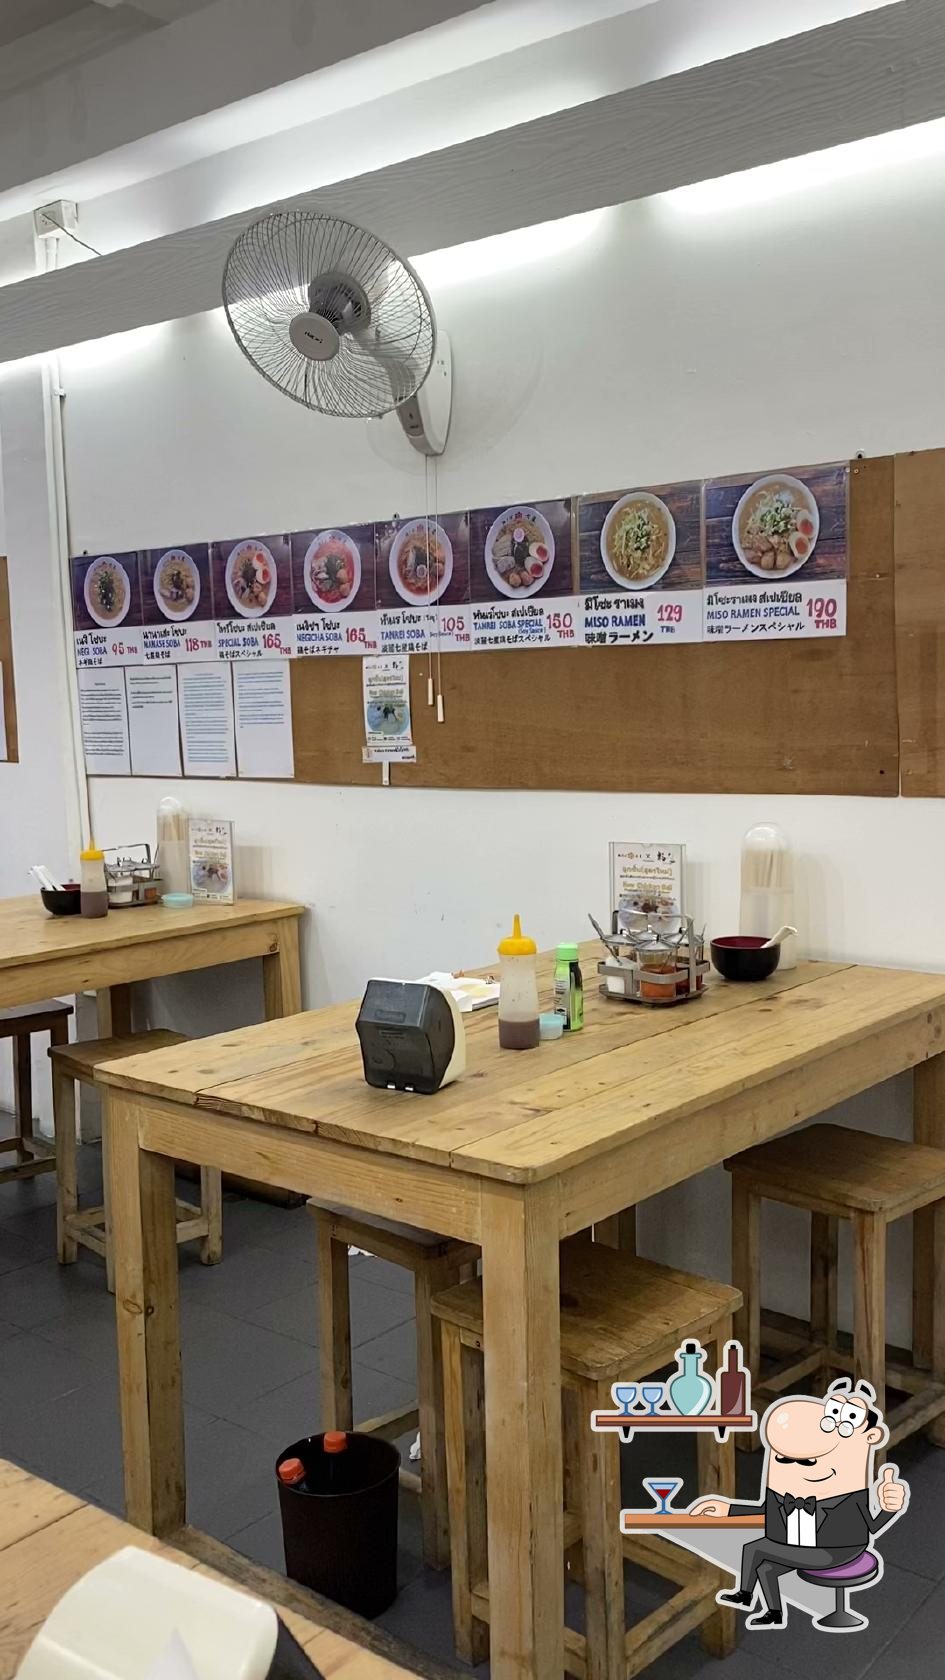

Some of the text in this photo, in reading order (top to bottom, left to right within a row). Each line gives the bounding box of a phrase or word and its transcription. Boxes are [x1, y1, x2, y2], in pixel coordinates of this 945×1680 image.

[657, 604, 683, 622] 129
[707, 606, 800, 620] MISO RAMEN SPECIAL
[806, 598, 837, 618] 190
[441, 616, 465, 632] 105
[473, 618, 543, 631] TANREI SOBA SPECIAL
[546, 613, 572, 629] 150
[584, 614, 646, 628] MISO RAMEN
[815, 619, 837, 629] THB
[296, 632, 343, 641] NEGICHA SOBA
[346, 628, 366, 643] 165
[381, 629, 425, 640] TANREI SOBA
[455, 633, 470, 641] THB
[556, 629, 575, 639] THB
[144, 640, 180, 648] NANASE SOBA
[185, 638, 212, 652] 118 THB
[218, 637, 259, 647] SPECIAL SOBA
[262, 633, 281, 649] 165
[364, 640, 377, 649] THB
[77, 646, 107, 656] NEGI SOBA
[112, 642, 124, 655] 95
[280, 647, 292, 655] THB
